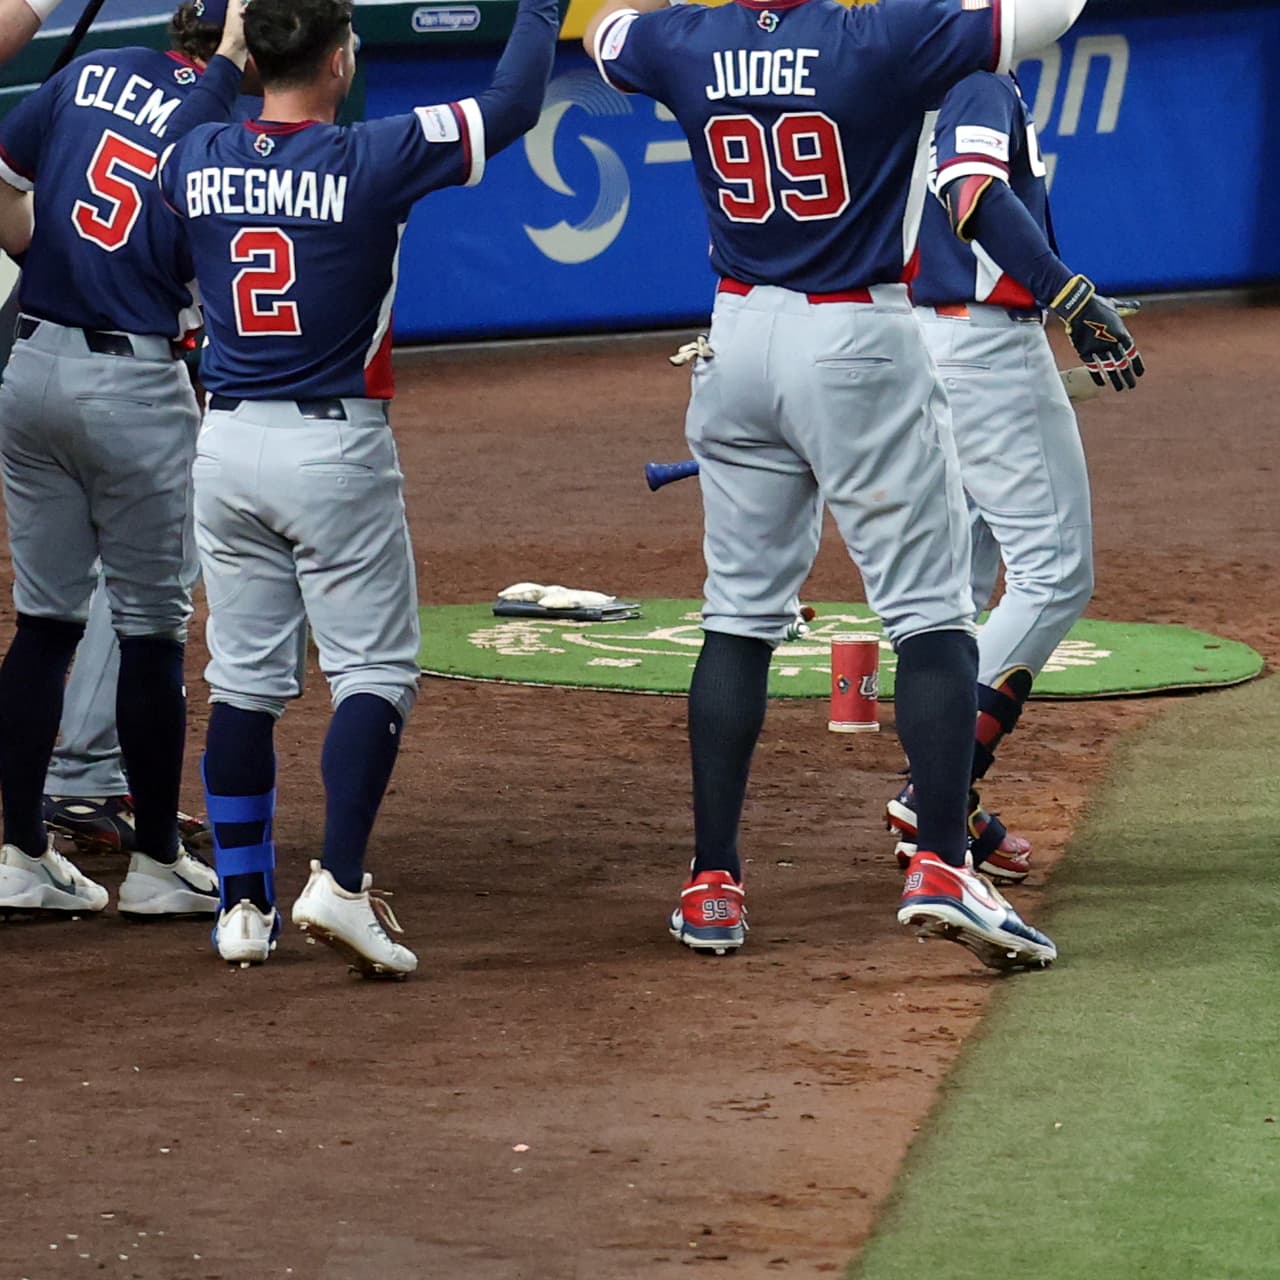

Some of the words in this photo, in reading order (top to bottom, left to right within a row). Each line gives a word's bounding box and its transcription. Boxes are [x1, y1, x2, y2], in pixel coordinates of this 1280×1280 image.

[74, 65, 182, 138] CLEM
[705, 48, 819, 100] JUDGE
[71, 128, 160, 252] 5
[186, 167, 347, 222] BREGMAN
[703, 111, 851, 224] 99
[230, 227, 302, 337] 2
